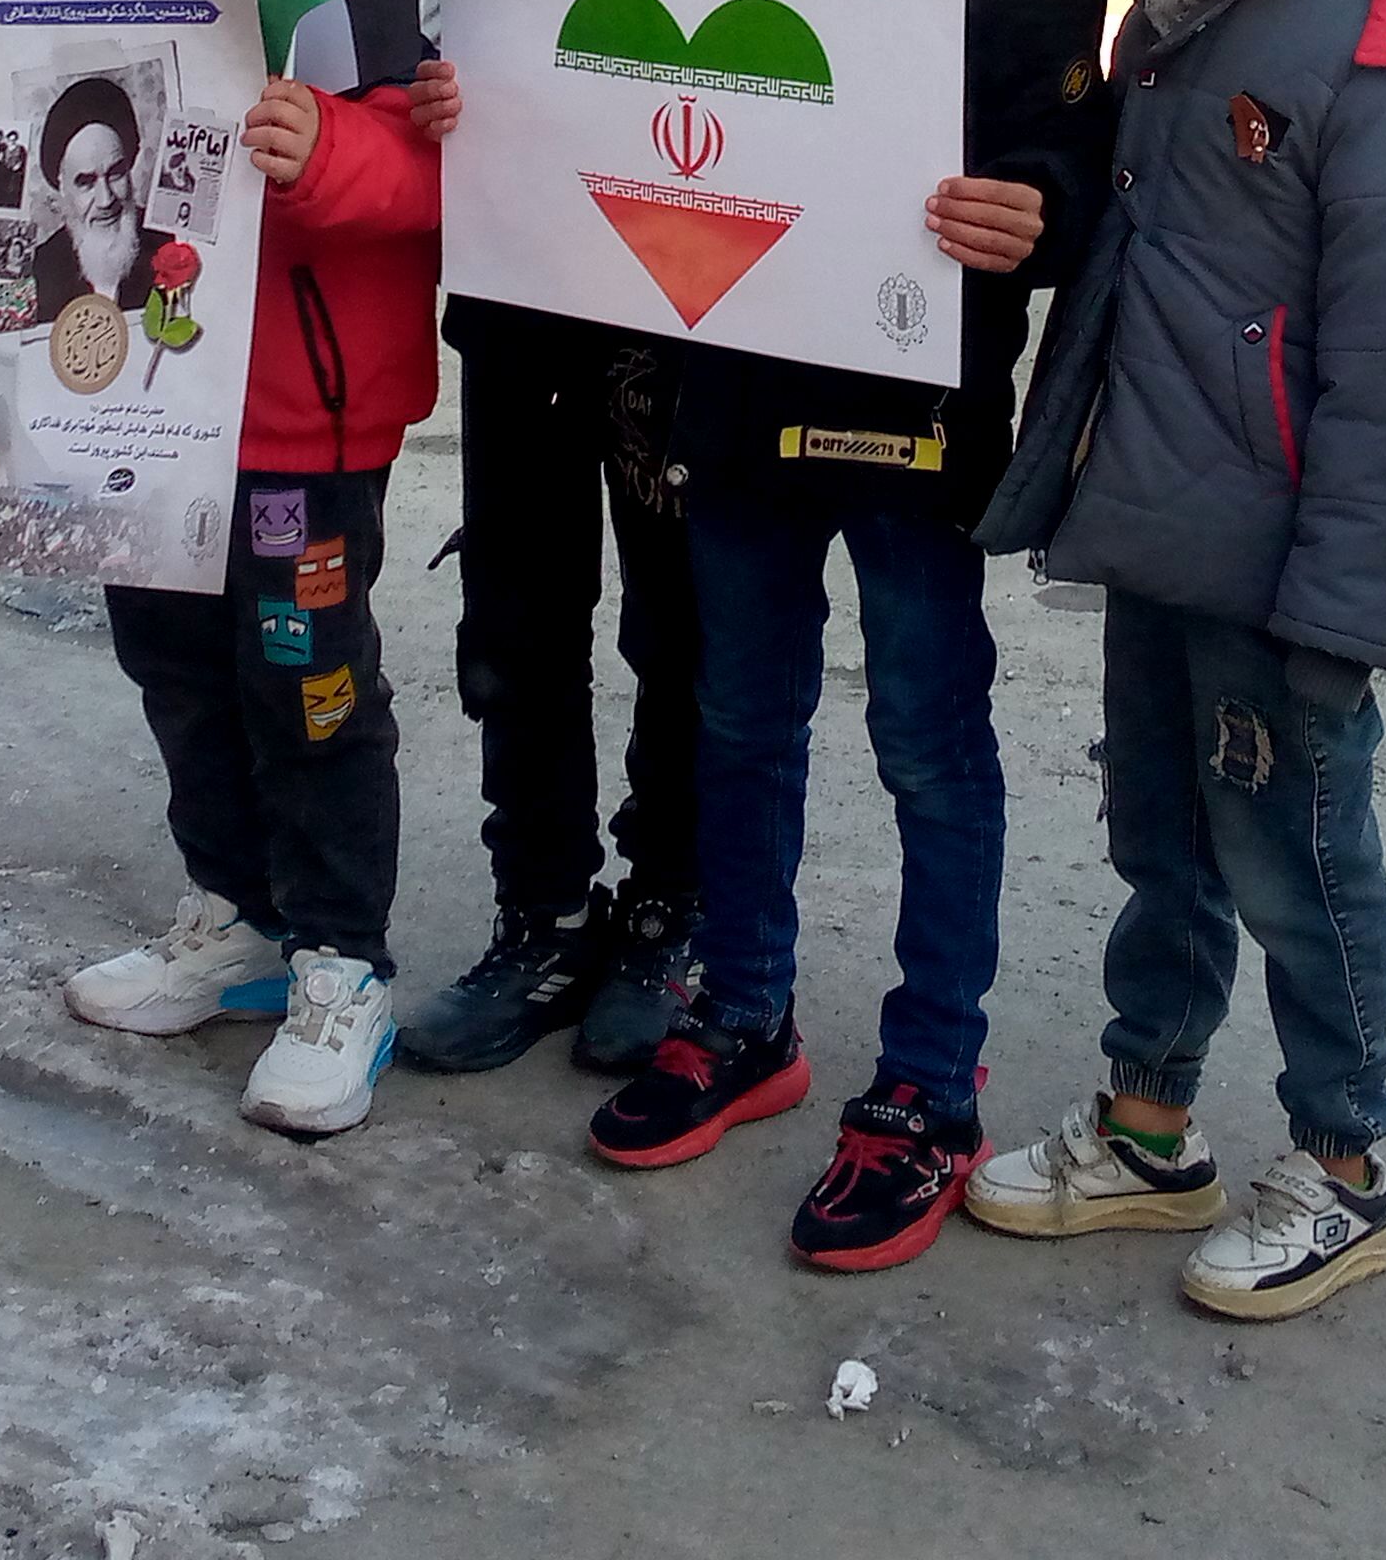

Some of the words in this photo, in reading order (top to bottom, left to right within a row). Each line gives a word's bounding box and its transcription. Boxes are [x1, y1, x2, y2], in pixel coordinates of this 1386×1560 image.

[166, 124, 201, 151] آمد
[193, 128, 229, 158] امام
[192, 425, 223, 441] کشوری
